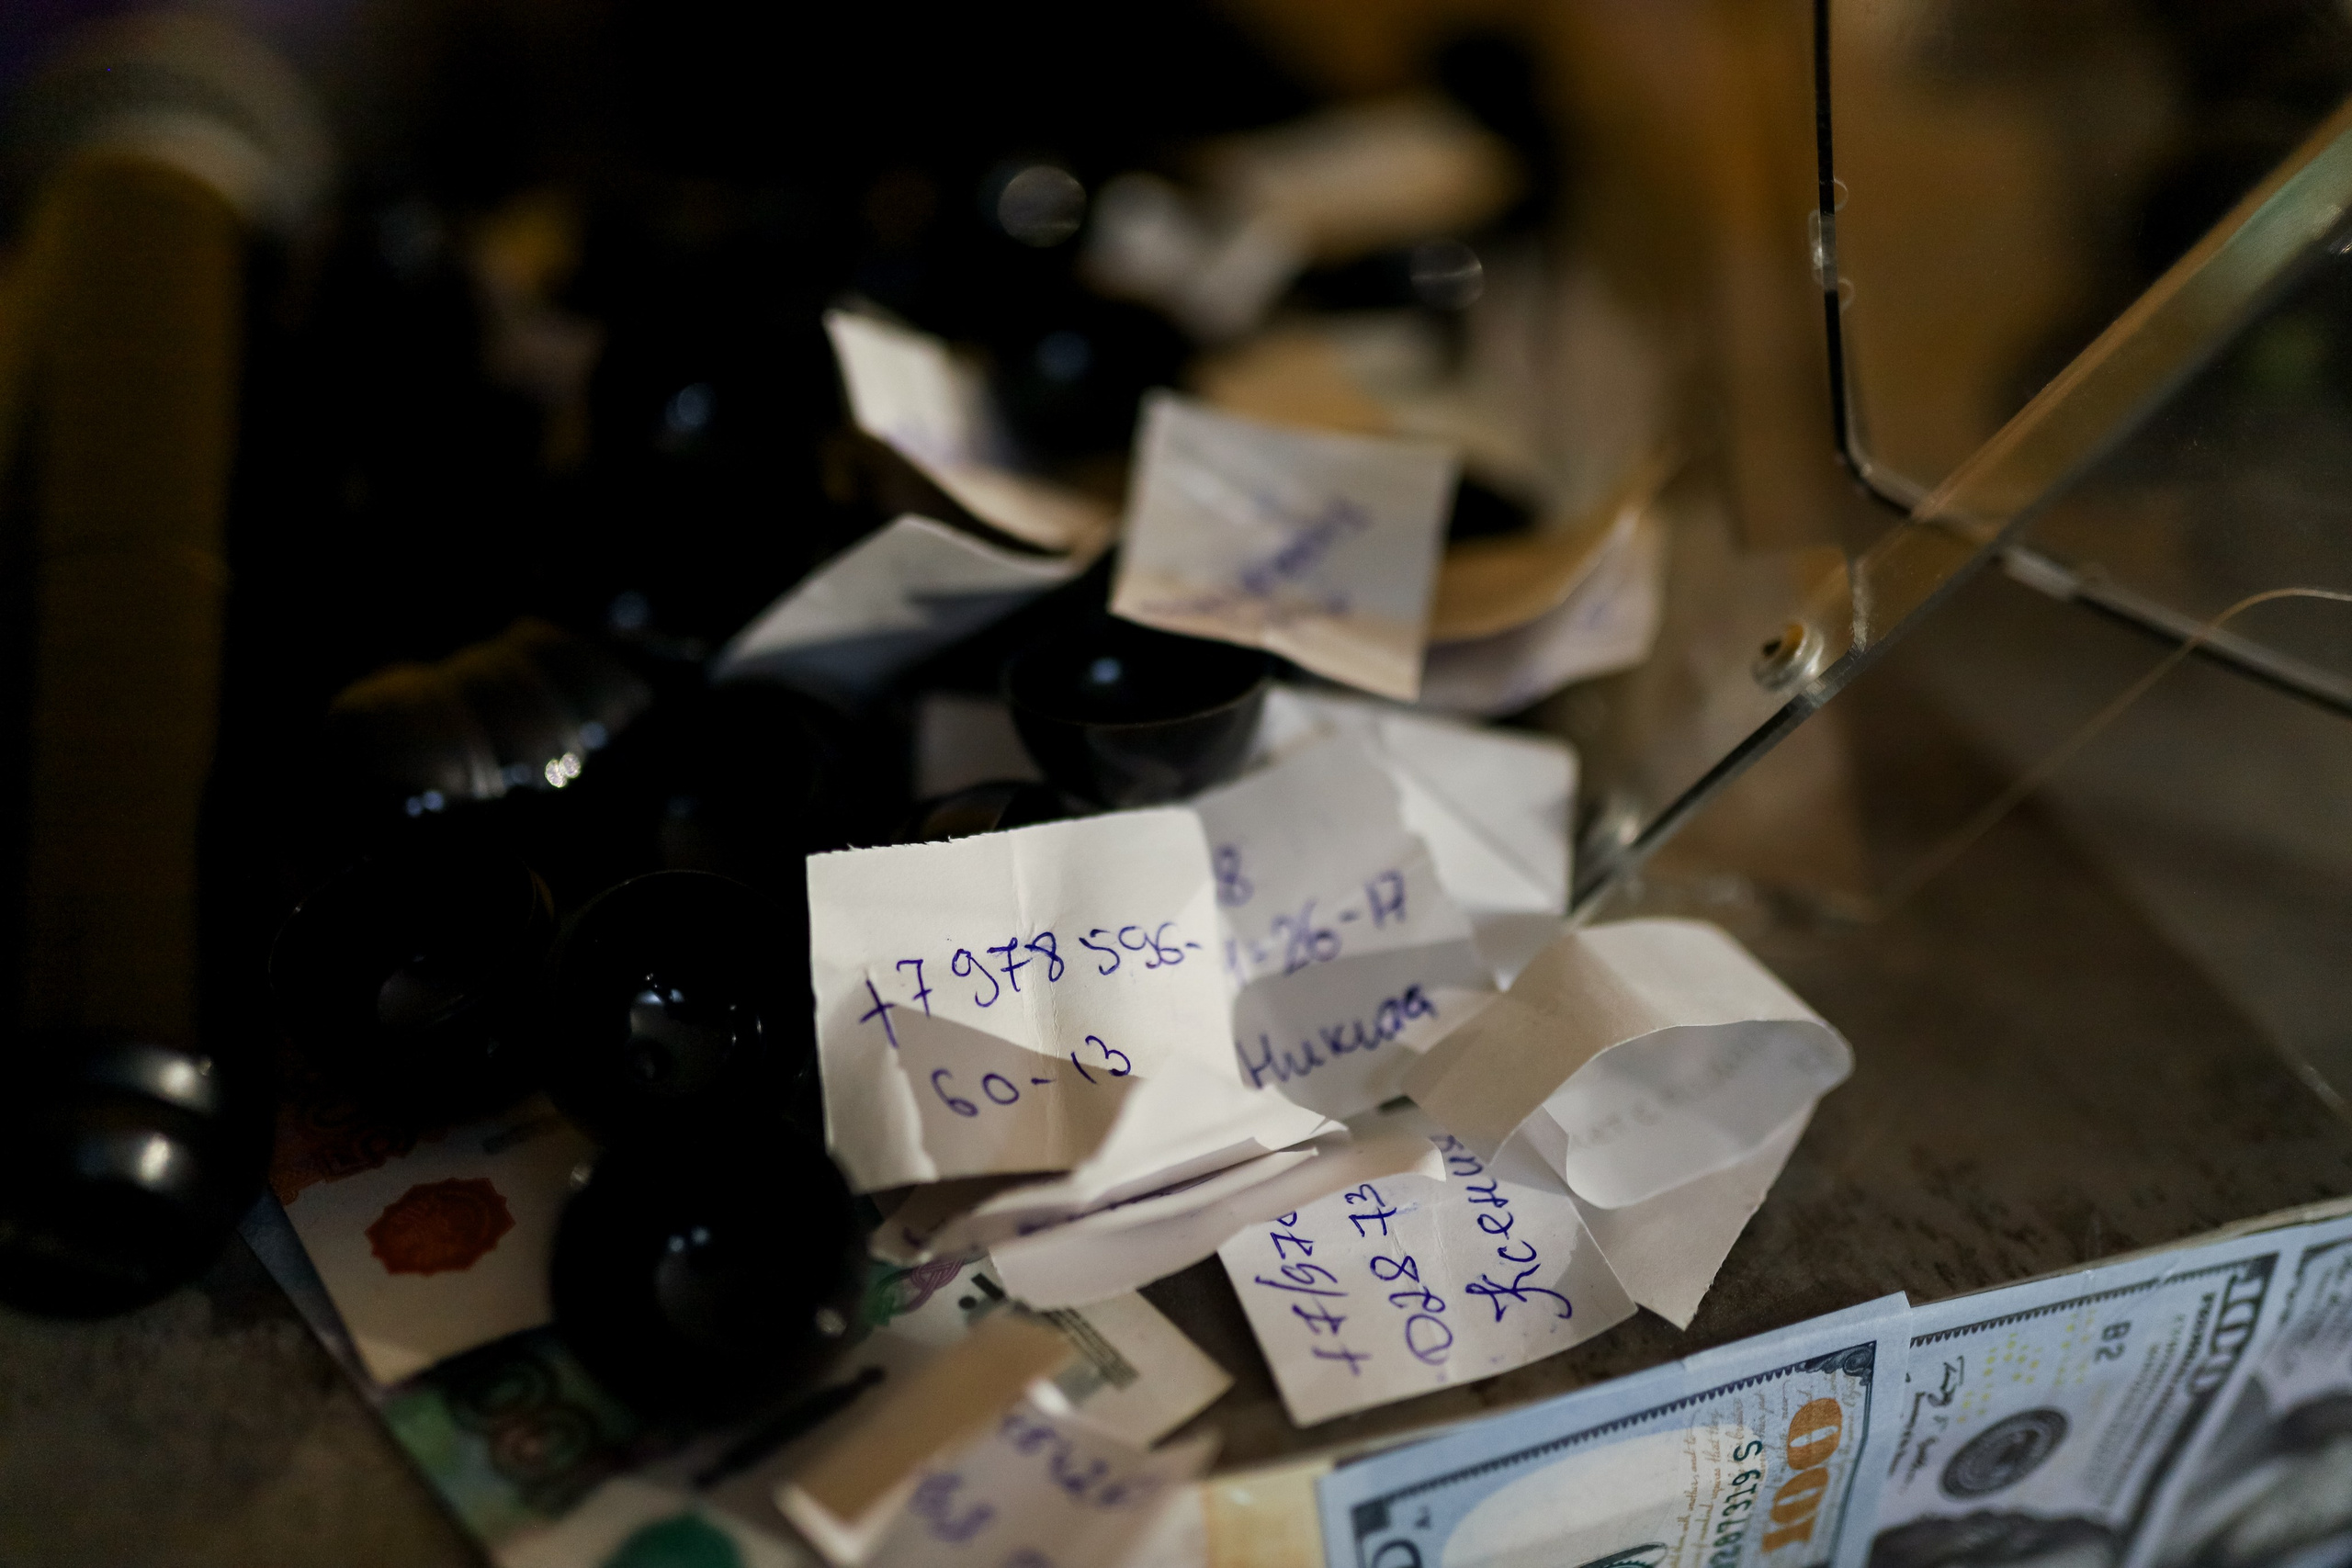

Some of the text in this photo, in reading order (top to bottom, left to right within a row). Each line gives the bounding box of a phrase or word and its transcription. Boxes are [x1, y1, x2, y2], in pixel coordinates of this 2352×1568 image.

[951, 931, 1066, 1007] 978
[1733, 1439, 1763, 1461] S
[1761, 1397, 1843, 1555] 100
